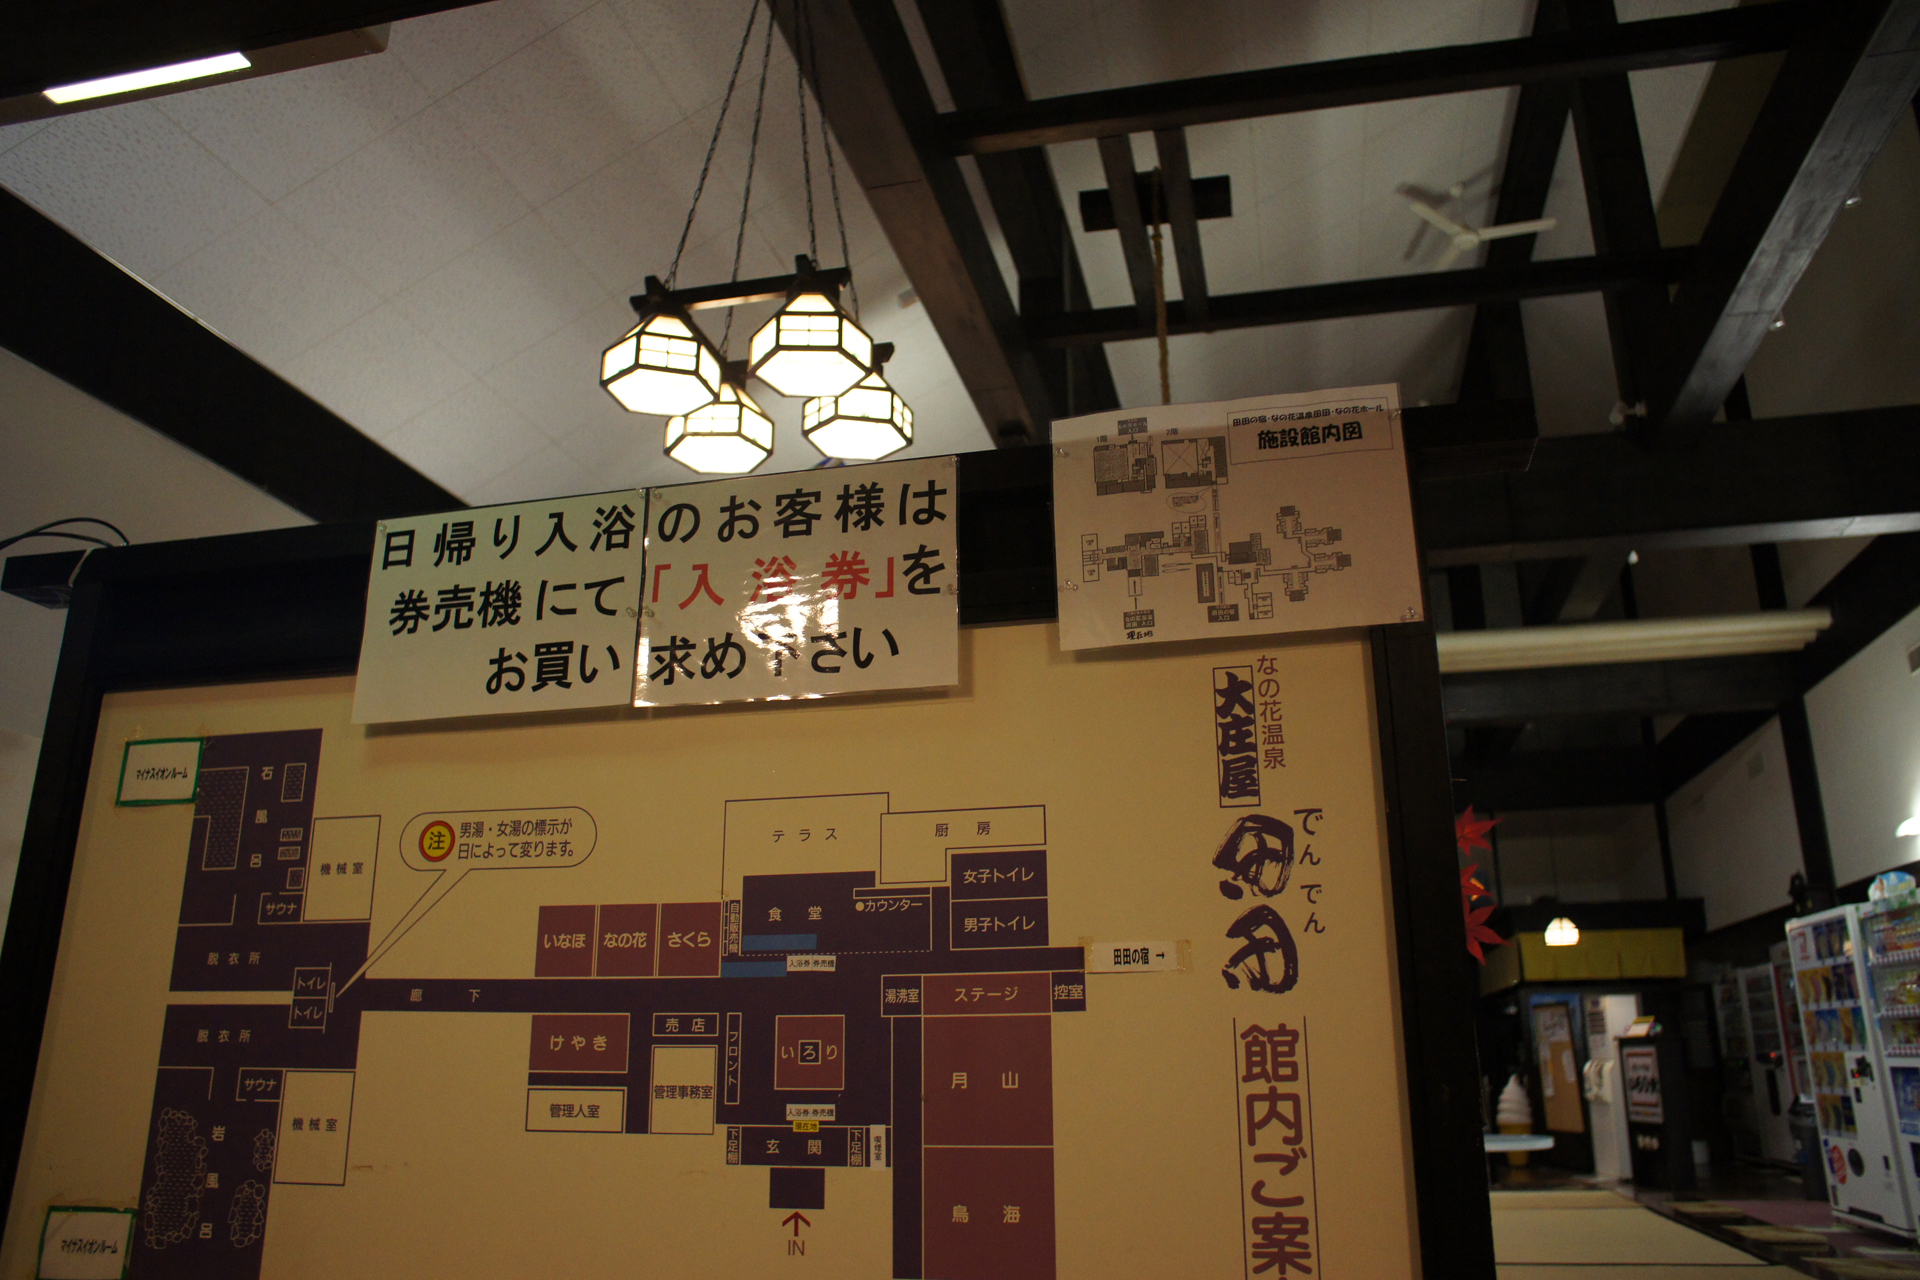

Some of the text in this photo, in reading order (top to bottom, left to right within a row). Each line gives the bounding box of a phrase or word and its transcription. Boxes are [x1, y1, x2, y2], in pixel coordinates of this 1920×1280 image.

[1258, 421, 1362, 450] 施設館内図
[381, 480, 947, 570] 日帰り入浴のお客様は
[1257, 655, 1286, 769] なの花温泉
[1215, 671, 1260, 799] 大庄屋
[135, 766, 189, 780] マイナスイオンルーム
[250, 766, 273, 868] 石風呂
[458, 818, 573, 839] 男湯・女湯の標示が
[772, 828, 837, 843] テラス
[935, 821, 991, 837] 厨房
[428, 831, 446, 850] 注
[458, 840, 575, 861] 日によって変ります。
[320, 861, 364, 876] 機械室
[963, 867, 1034, 883] 女子トイレ
[1294, 808, 1326, 934] でんでん
[265, 901, 297, 916] サウナ
[865, 898, 923, 912] カウンター
[768, 906, 823, 921] 食堂
[729, 902, 740, 954] 自動販売機
[964, 915, 1036, 932] 男子トイレ
[544, 933, 586, 949] いなほ
[604, 932, 647, 948] なの花
[668, 931, 711, 948] さくら
[207, 951, 261, 966] 脱衣所
[788, 958, 835, 968] 入浴券 券売機
[1113, 947, 1149, 966] 田田の宿
[297, 976, 326, 991] トイレ
[410, 988, 481, 1003] 廊下
[884, 988, 920, 1004] 湯沸室
[954, 986, 1019, 1002] ステージ
[1053, 984, 1084, 1000] 控室
[293, 1005, 323, 1021] トイレ
[665, 1017, 706, 1032] 売店
[197, 1029, 252, 1044] 脱衣所
[550, 1035, 607, 1051] けやき
[728, 1031, 738, 1086] フロント
[781, 1044, 838, 1060] いろり
[244, 1078, 277, 1092] サウナ
[951, 1071, 1019, 1089] 月山
[654, 1085, 713, 1100] 管理事務室
[550, 1104, 600, 1118] 管理人室
[786, 1108, 834, 1117] 入浴券 券売機
[292, 1118, 338, 1132] 機械室
[794, 1121, 818, 1131] 現在地
[727, 1128, 739, 1164] 下足棚
[766, 1139, 822, 1156] 玄関
[850, 1129, 863, 1166] 下足棚
[874, 1135, 882, 1161] 喫煙室
[1240, 1023, 1312, 1280] 館内ご案
[199, 1124, 226, 1239] 岩風呂
[952, 1204, 1021, 1223] 鳥海
[60, 1238, 118, 1256] マイナスイオンルーム
[788, 1239, 805, 1256] IN
